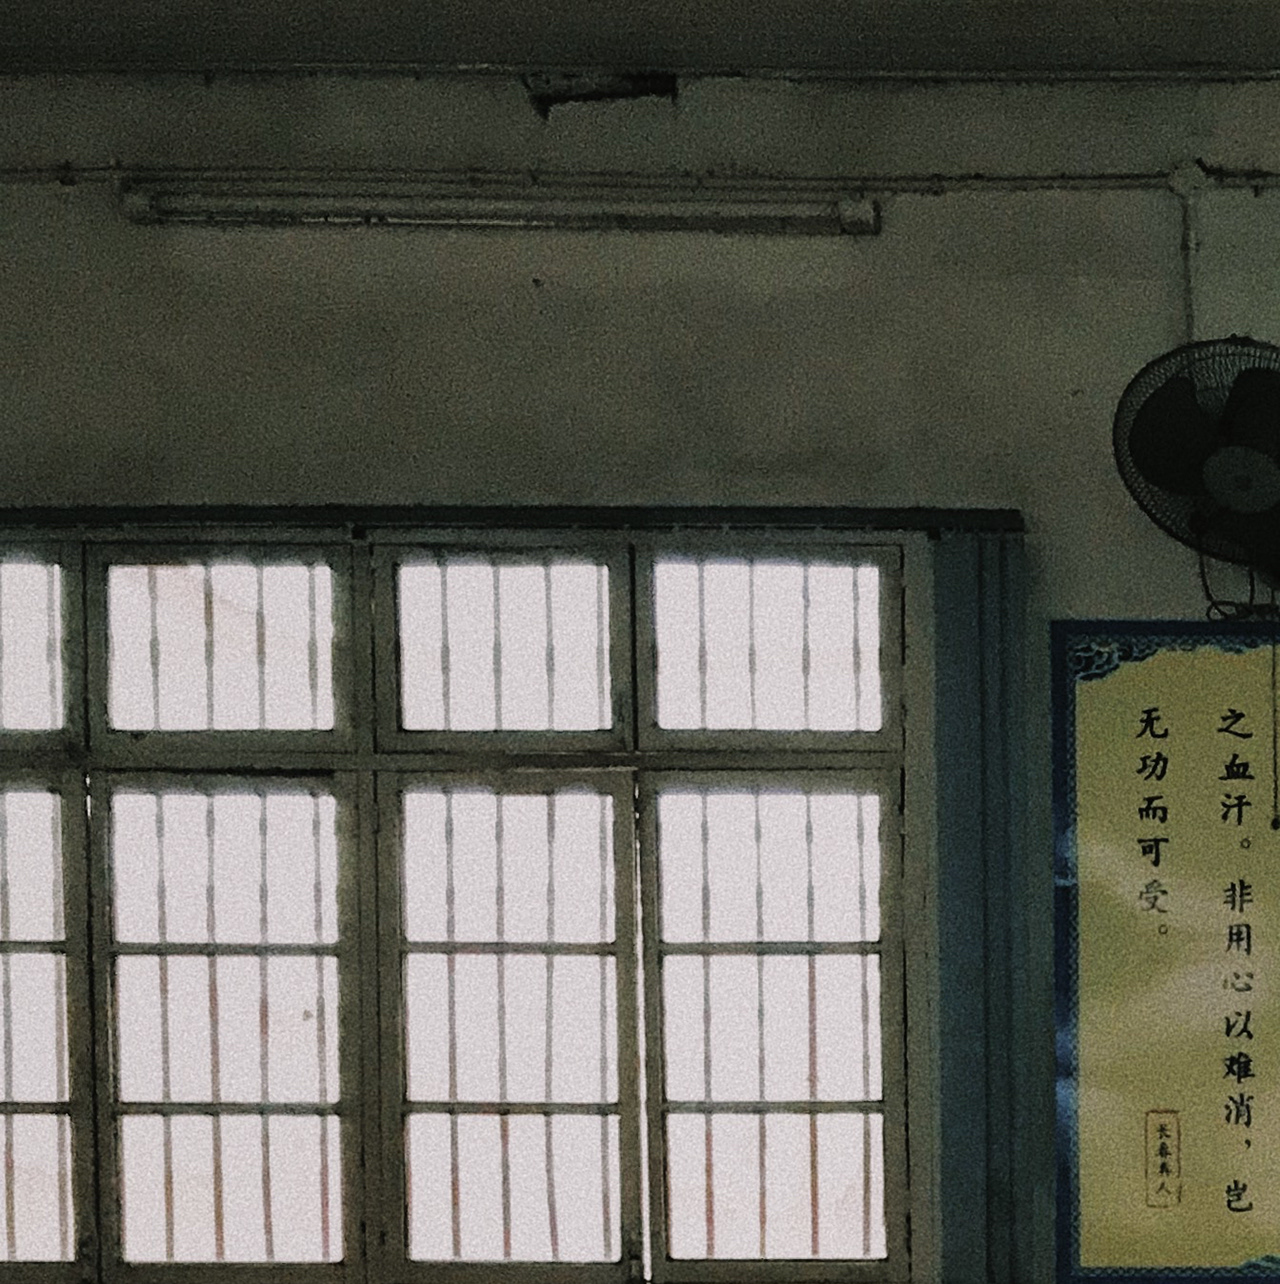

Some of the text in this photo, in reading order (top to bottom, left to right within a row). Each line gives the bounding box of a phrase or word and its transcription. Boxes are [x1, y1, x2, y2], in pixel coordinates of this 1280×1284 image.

[1135, 707, 1169, 937] 无功而可受。
[1217, 707, 1256, 1215] 之血汗。非用心以难消，岂
